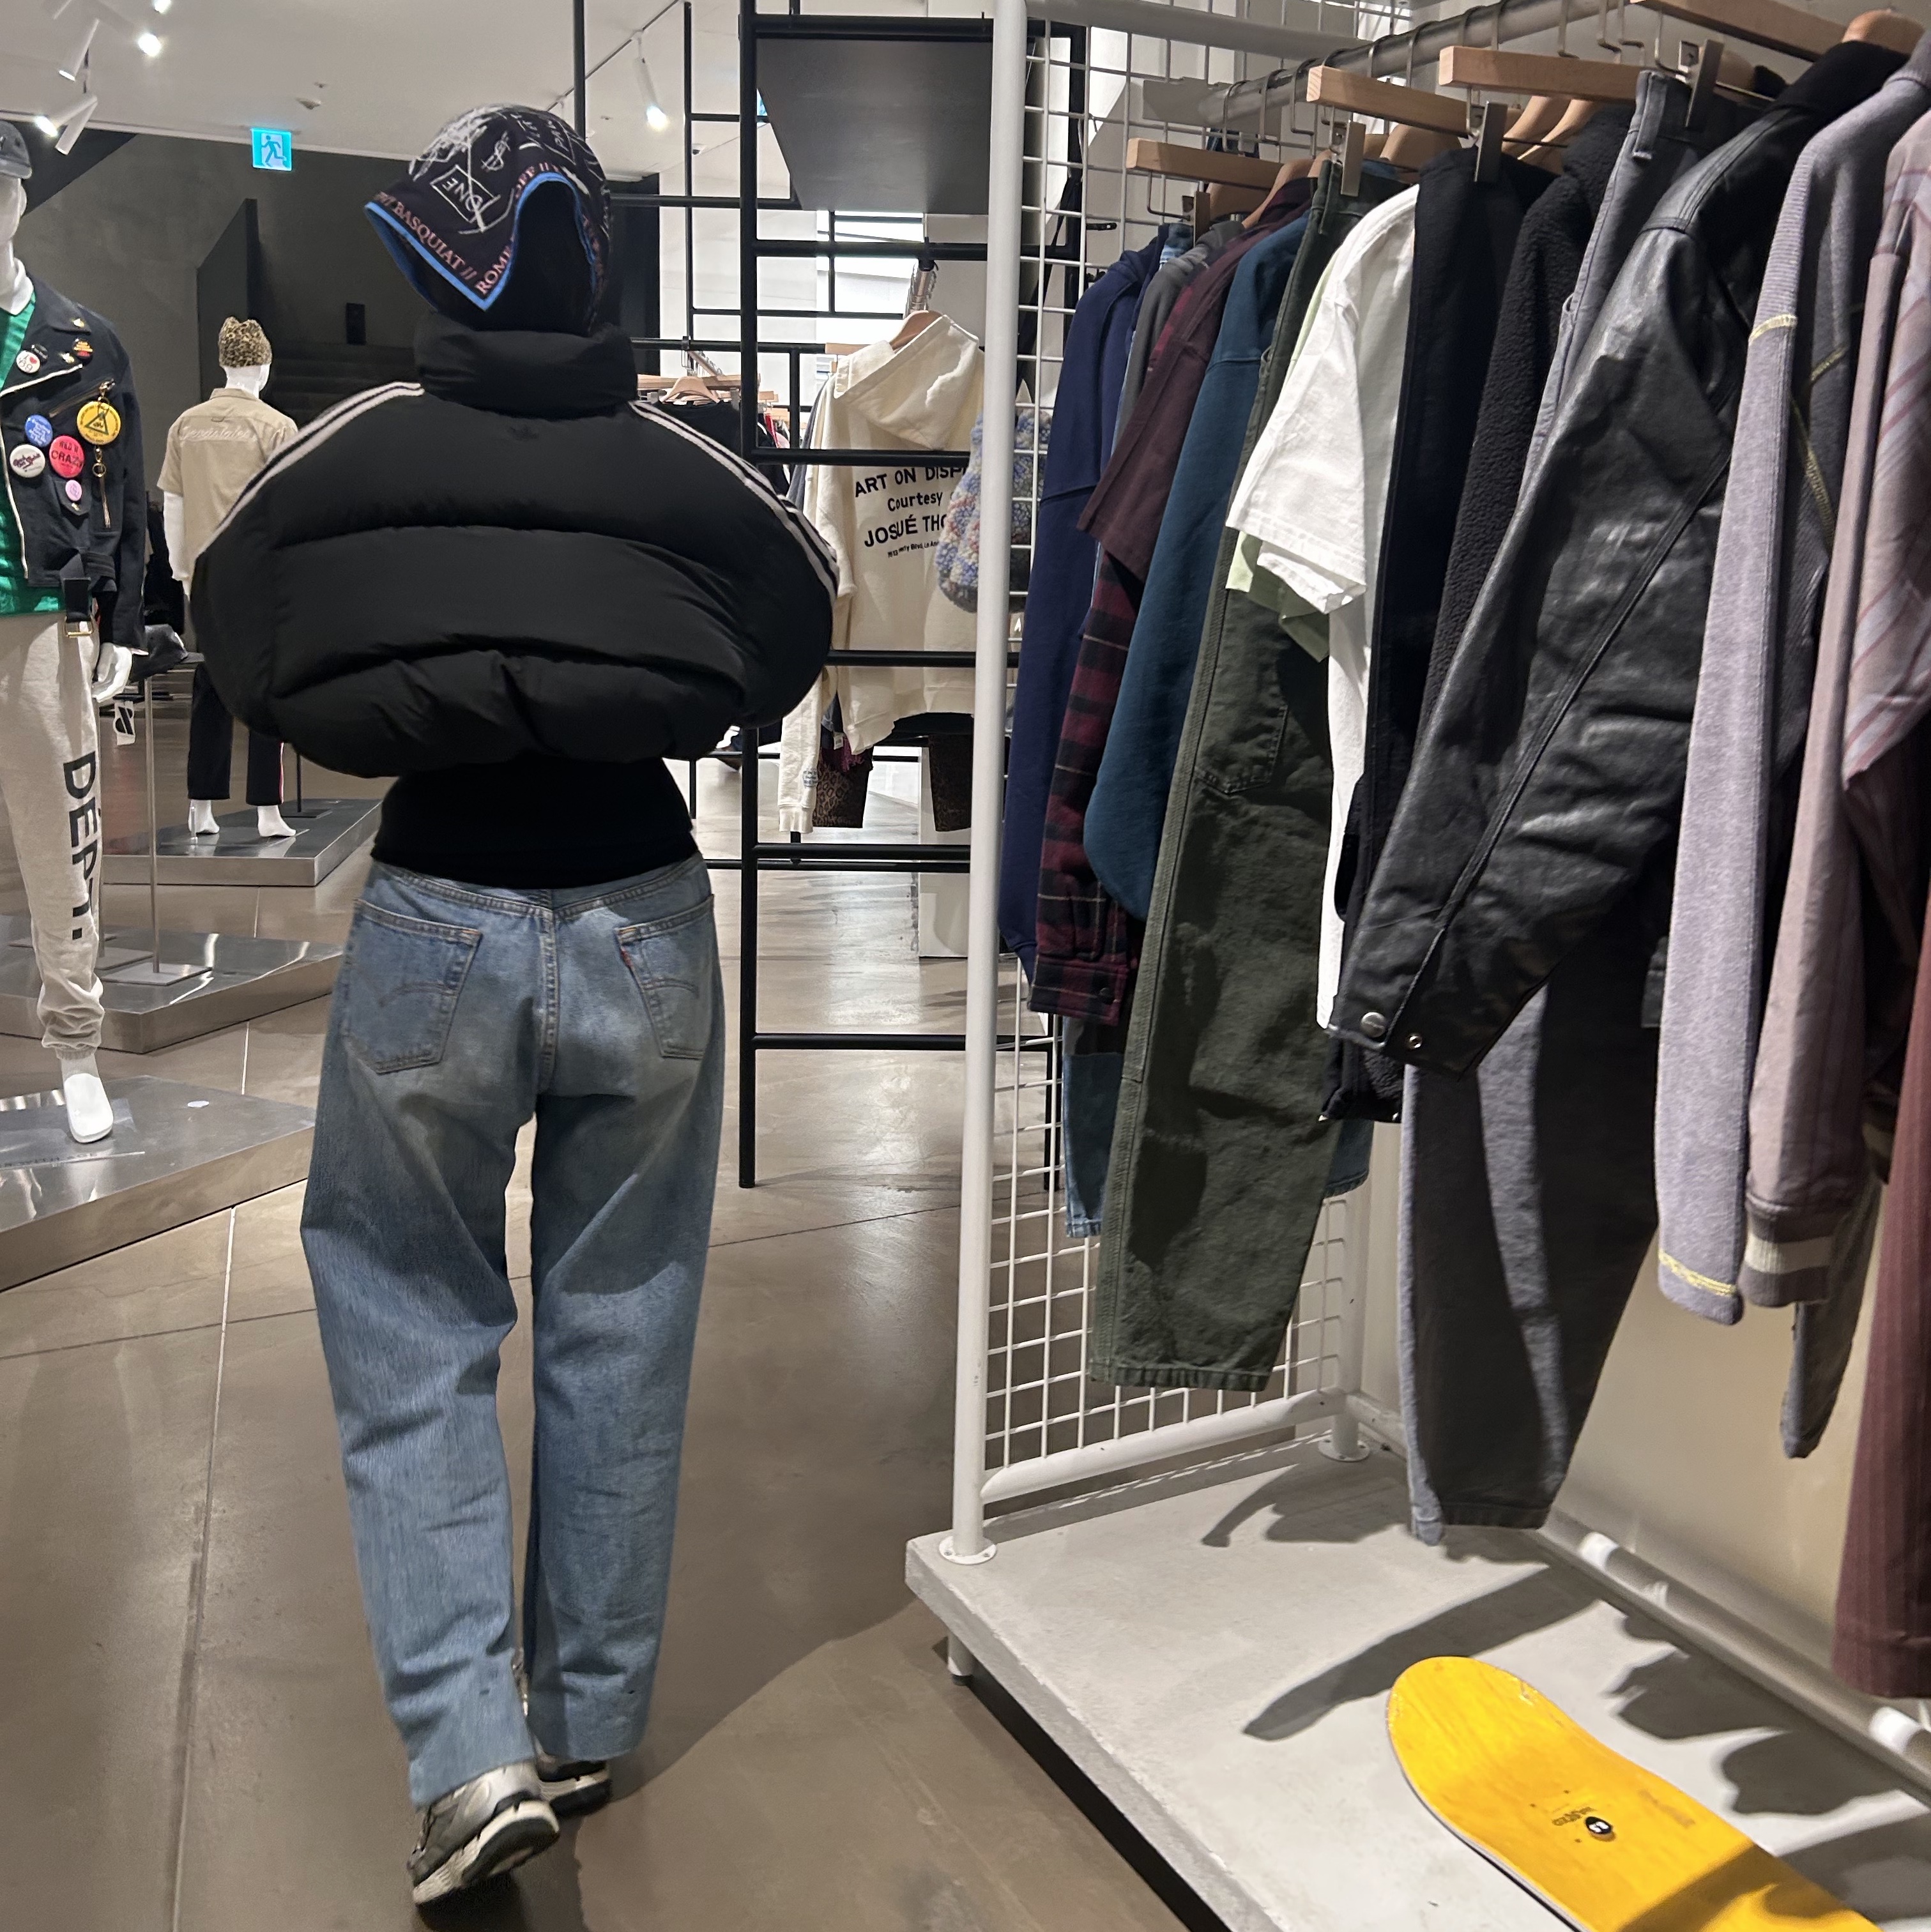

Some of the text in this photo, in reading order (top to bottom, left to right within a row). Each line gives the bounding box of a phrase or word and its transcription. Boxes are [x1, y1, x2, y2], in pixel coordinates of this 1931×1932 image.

[392, 201, 466, 270] BASQUIAT
[855, 473, 887, 498] ART
[894, 468, 917, 485] ON
[887, 492, 943, 512] Courtesy
[864, 514, 918, 547] JOSUÉ
